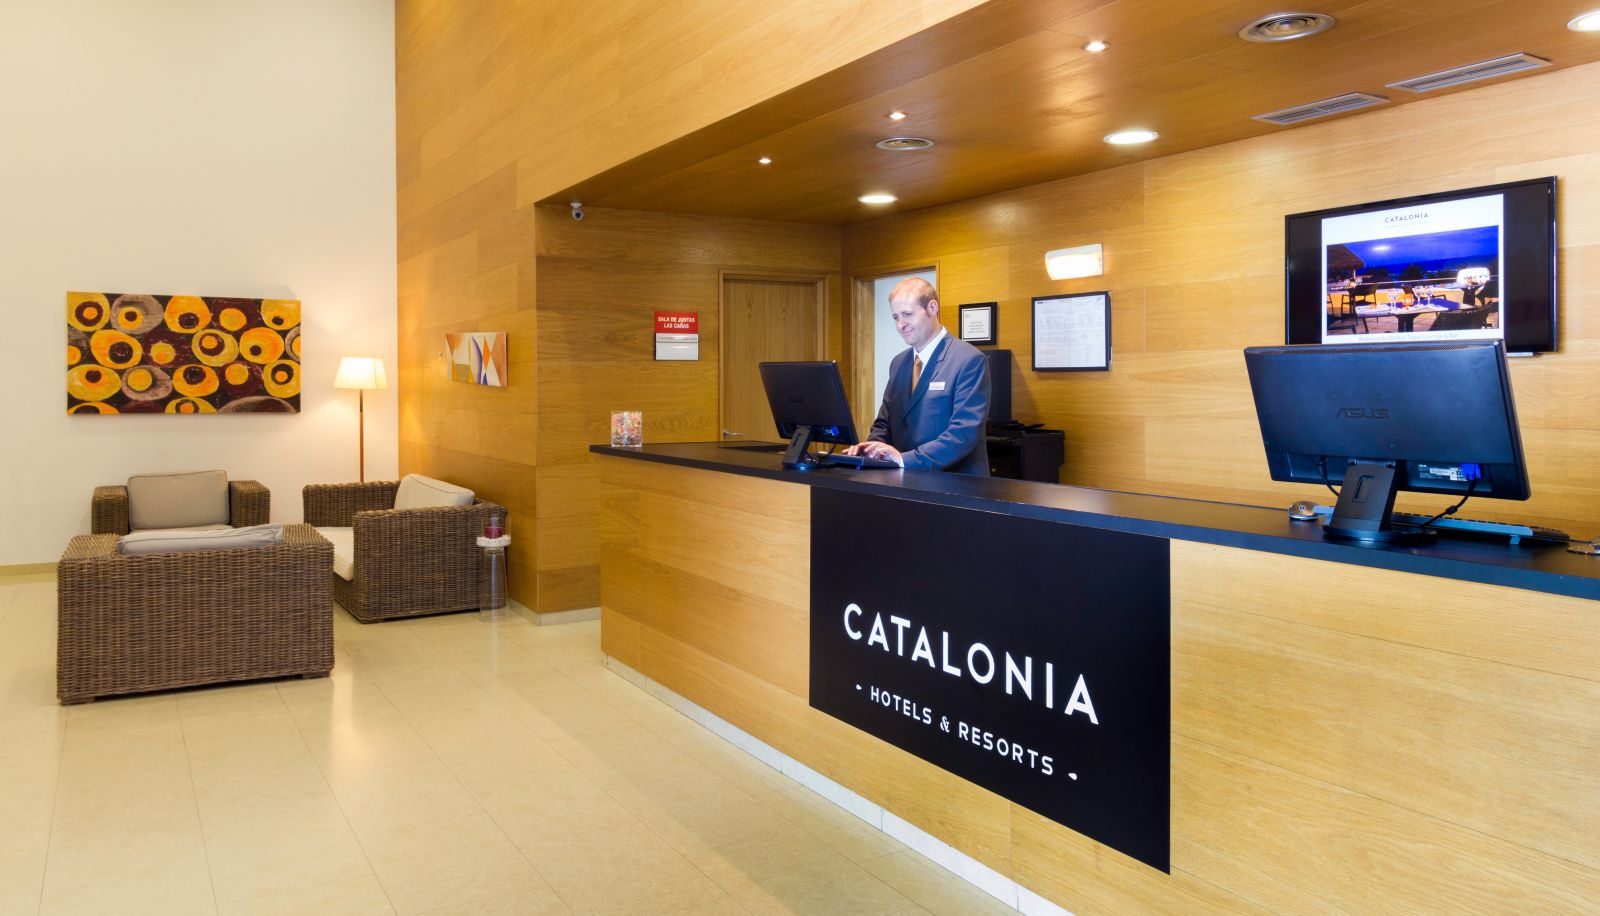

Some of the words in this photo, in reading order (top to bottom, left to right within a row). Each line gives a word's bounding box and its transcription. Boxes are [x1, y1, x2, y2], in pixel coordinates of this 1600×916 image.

[1384, 213, 1429, 223] CATALONIA
[1335, 408, 1390, 419] ASUS
[843, 603, 1099, 725] CATALONIA
[870, 685, 932, 725] HOTELS
[939, 715, 951, 733] &
[958, 721, 1054, 776] RESORTS
